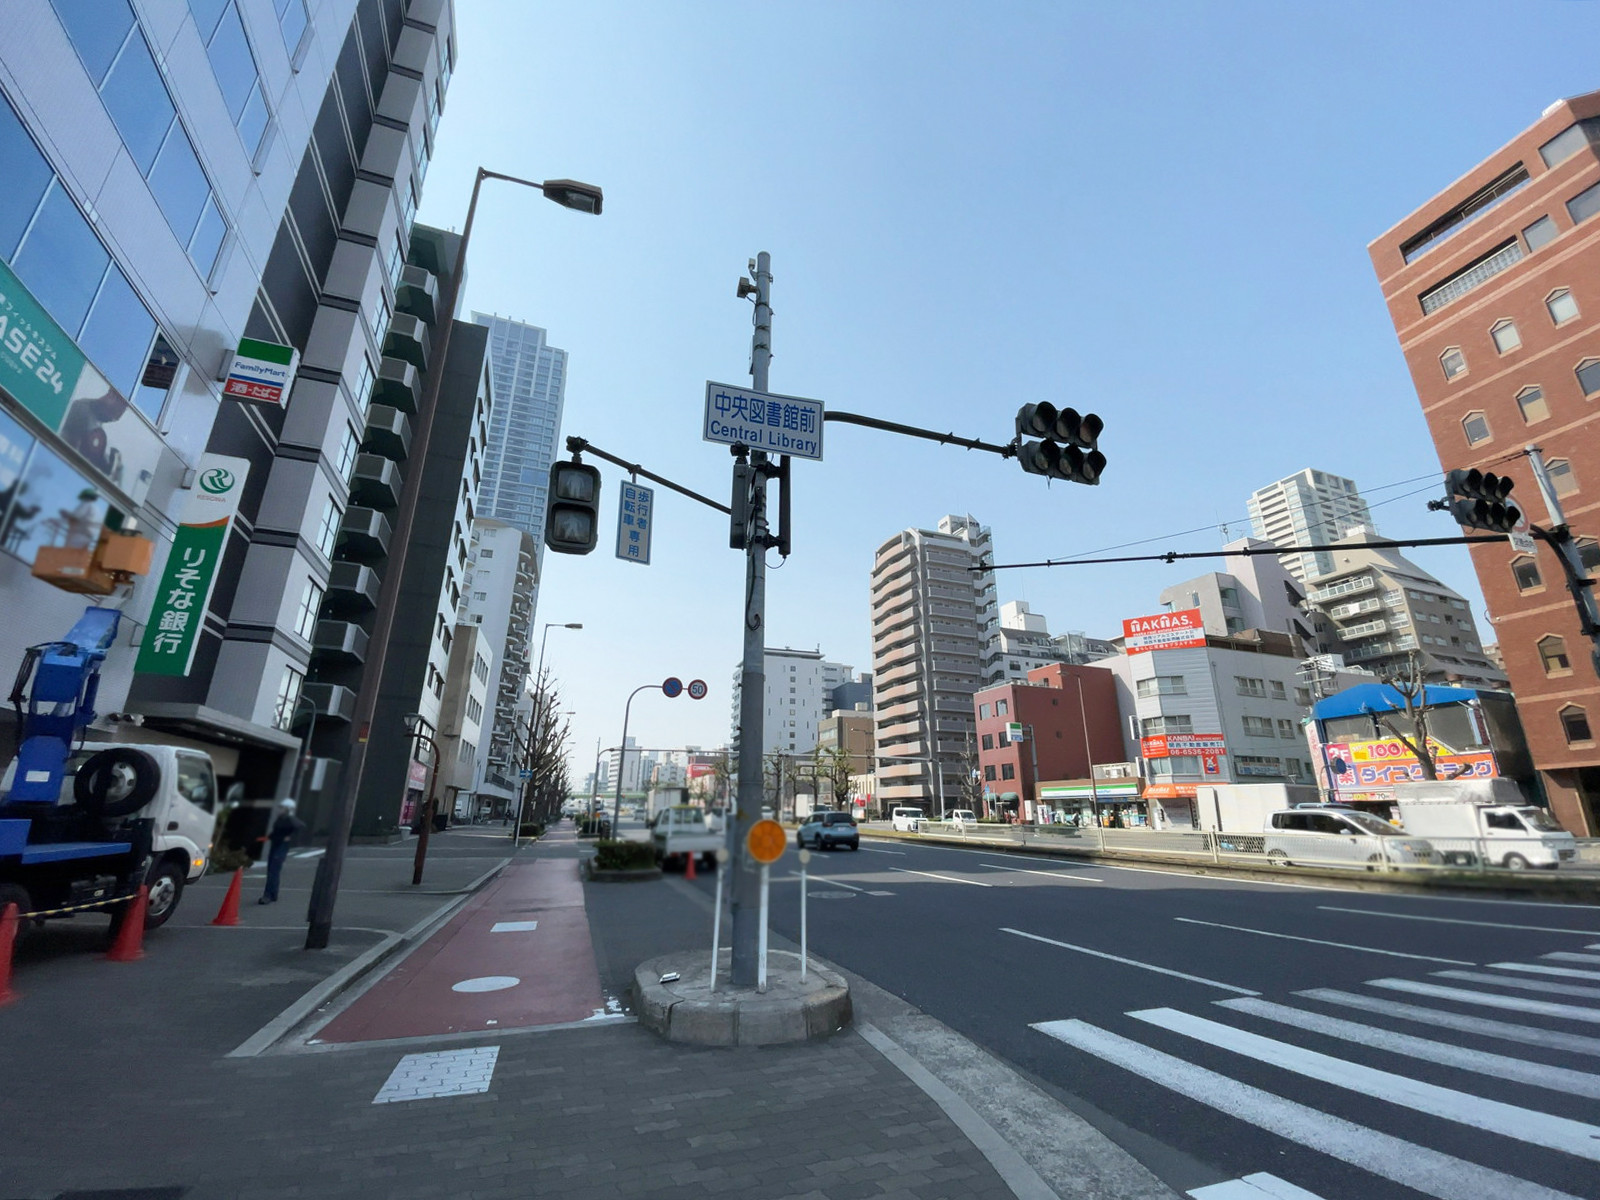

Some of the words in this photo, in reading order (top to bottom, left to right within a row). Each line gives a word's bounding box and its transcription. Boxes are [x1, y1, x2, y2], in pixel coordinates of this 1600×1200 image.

[235, 361, 286, 377] FamilyMart
[714, 391, 816, 434] 中央図書館前
[710, 420, 763, 444] Central
[768, 434, 818, 455] Library
[623, 487, 636, 527] 自転車
[637, 491, 649, 530] 歩行者
[627, 530, 641, 558] 専用
[153, 547, 206, 655] りそな銀行
[692, 684, 703, 695] 50
